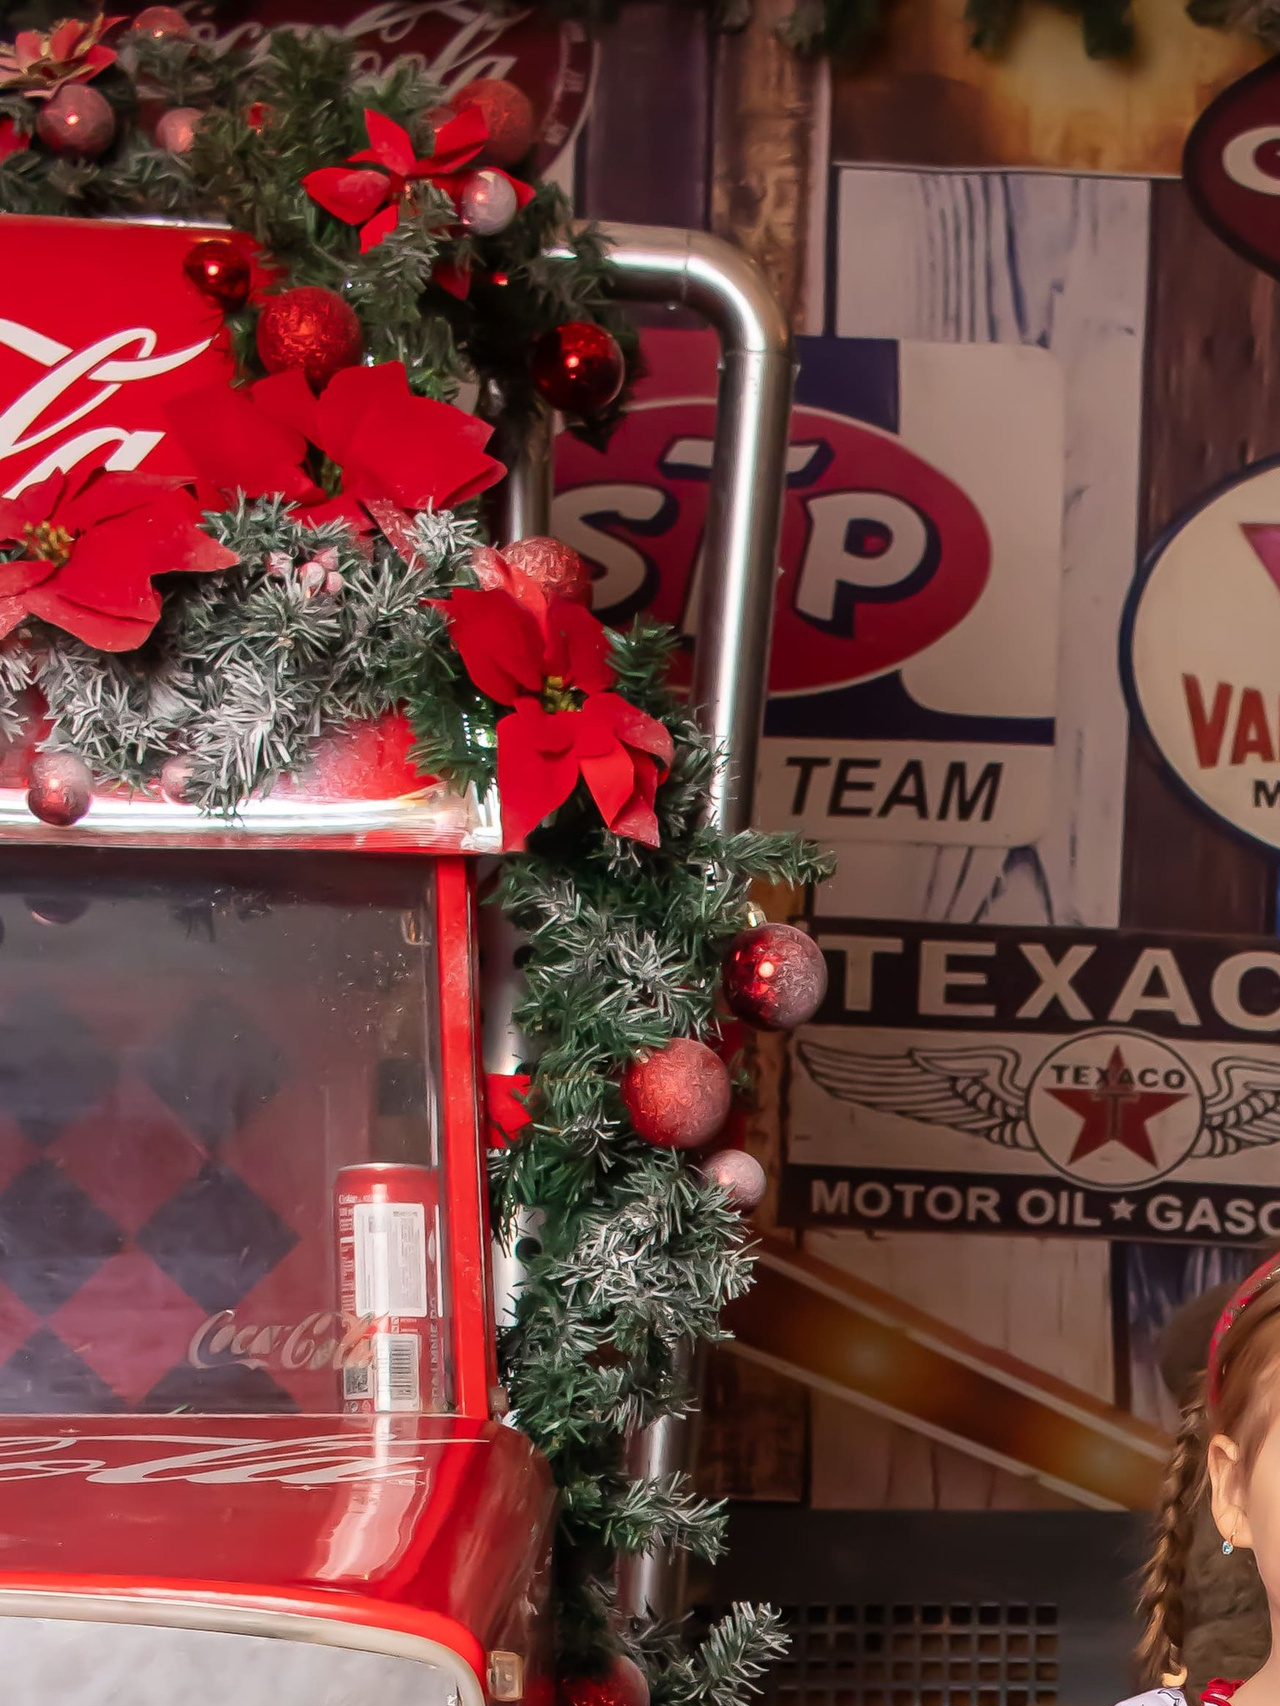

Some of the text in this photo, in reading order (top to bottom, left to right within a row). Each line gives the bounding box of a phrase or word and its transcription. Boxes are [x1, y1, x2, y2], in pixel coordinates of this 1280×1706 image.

[785, 756, 1003, 822] TEAM
[1051, 1064, 1187, 1089] TEXACO
[811, 1180, 1000, 1223] MOTOR
[1019, 1187, 1101, 1227] OIL
